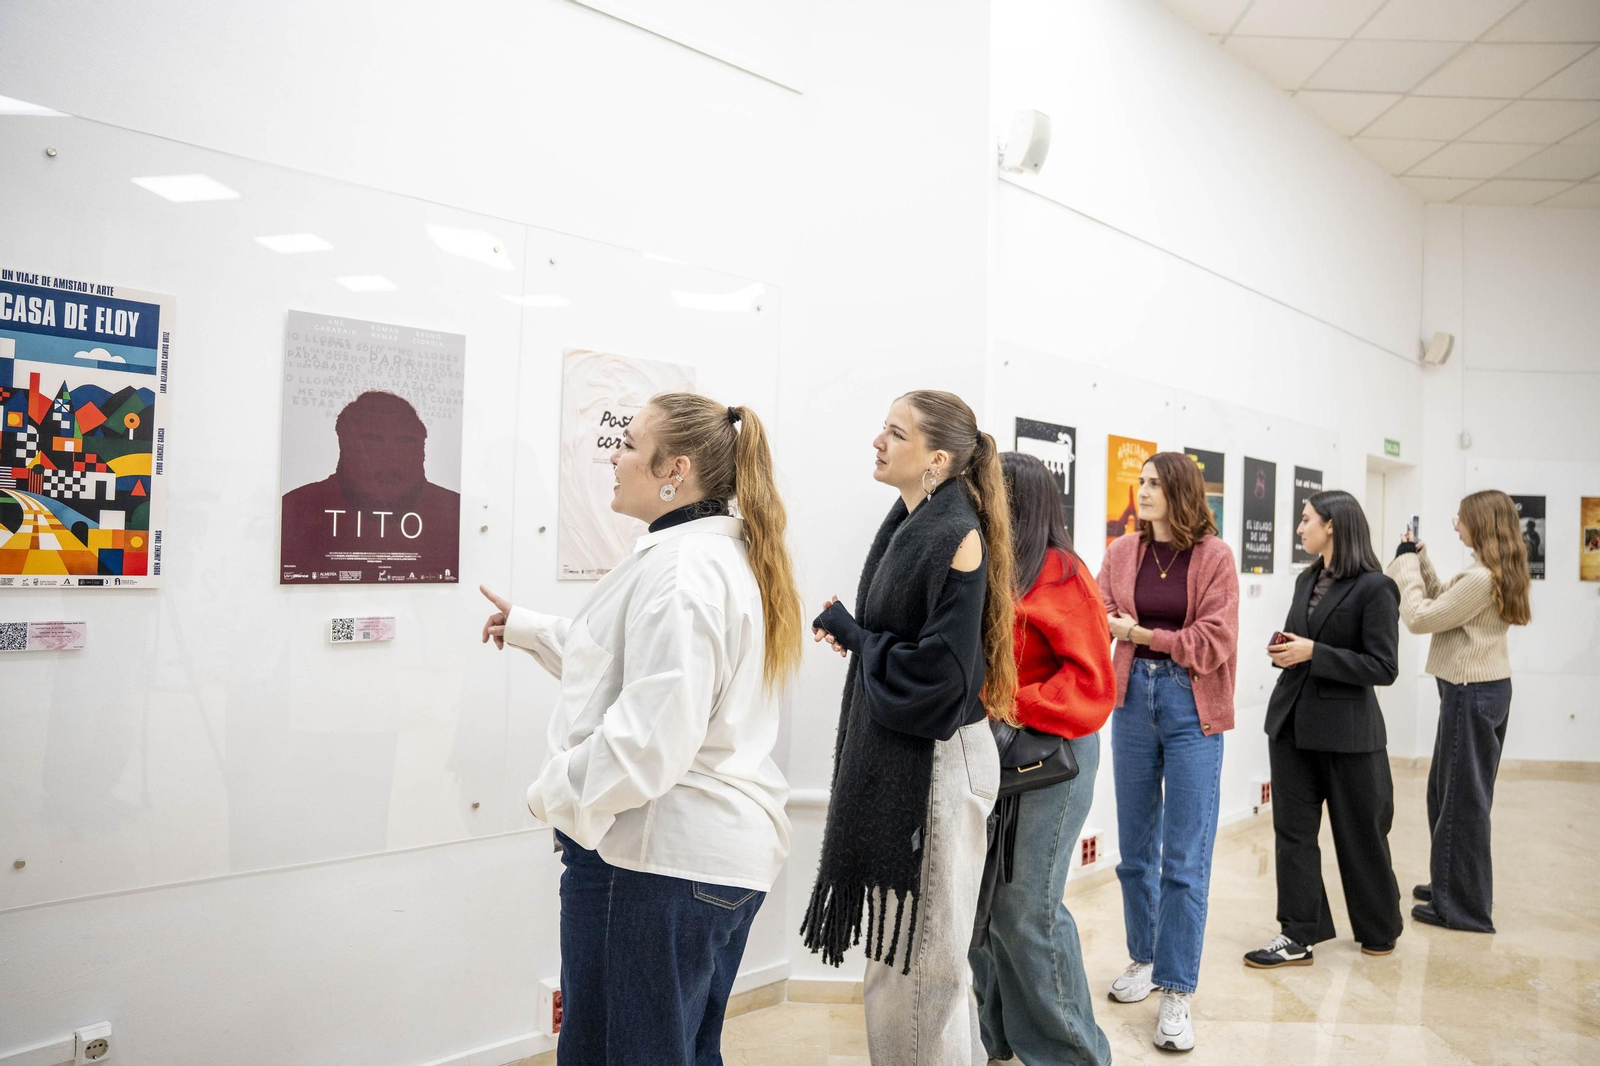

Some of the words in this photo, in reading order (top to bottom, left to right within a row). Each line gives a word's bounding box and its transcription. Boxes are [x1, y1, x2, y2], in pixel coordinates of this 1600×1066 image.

[1, 269, 13, 281] UN
[16, 271, 39, 285] VIAJE
[41, 275, 51, 287] DE
[53, 277, 88, 293] AMISTAD
[89, 283, 95, 293] Y
[96, 285, 114, 297] ARTE
[0, 292, 56, 327] CASA
[64, 302, 89, 332] DE
[95, 306, 140, 338] ELOY
[327, 318, 344, 327] ANE
[314, 324, 357, 336] GABARAIN
[370, 324, 400, 334] ROMAN
[415, 331, 442, 340] BRUNO
[431, 369, 464, 380] GORD
[324, 509, 423, 539] TITO
